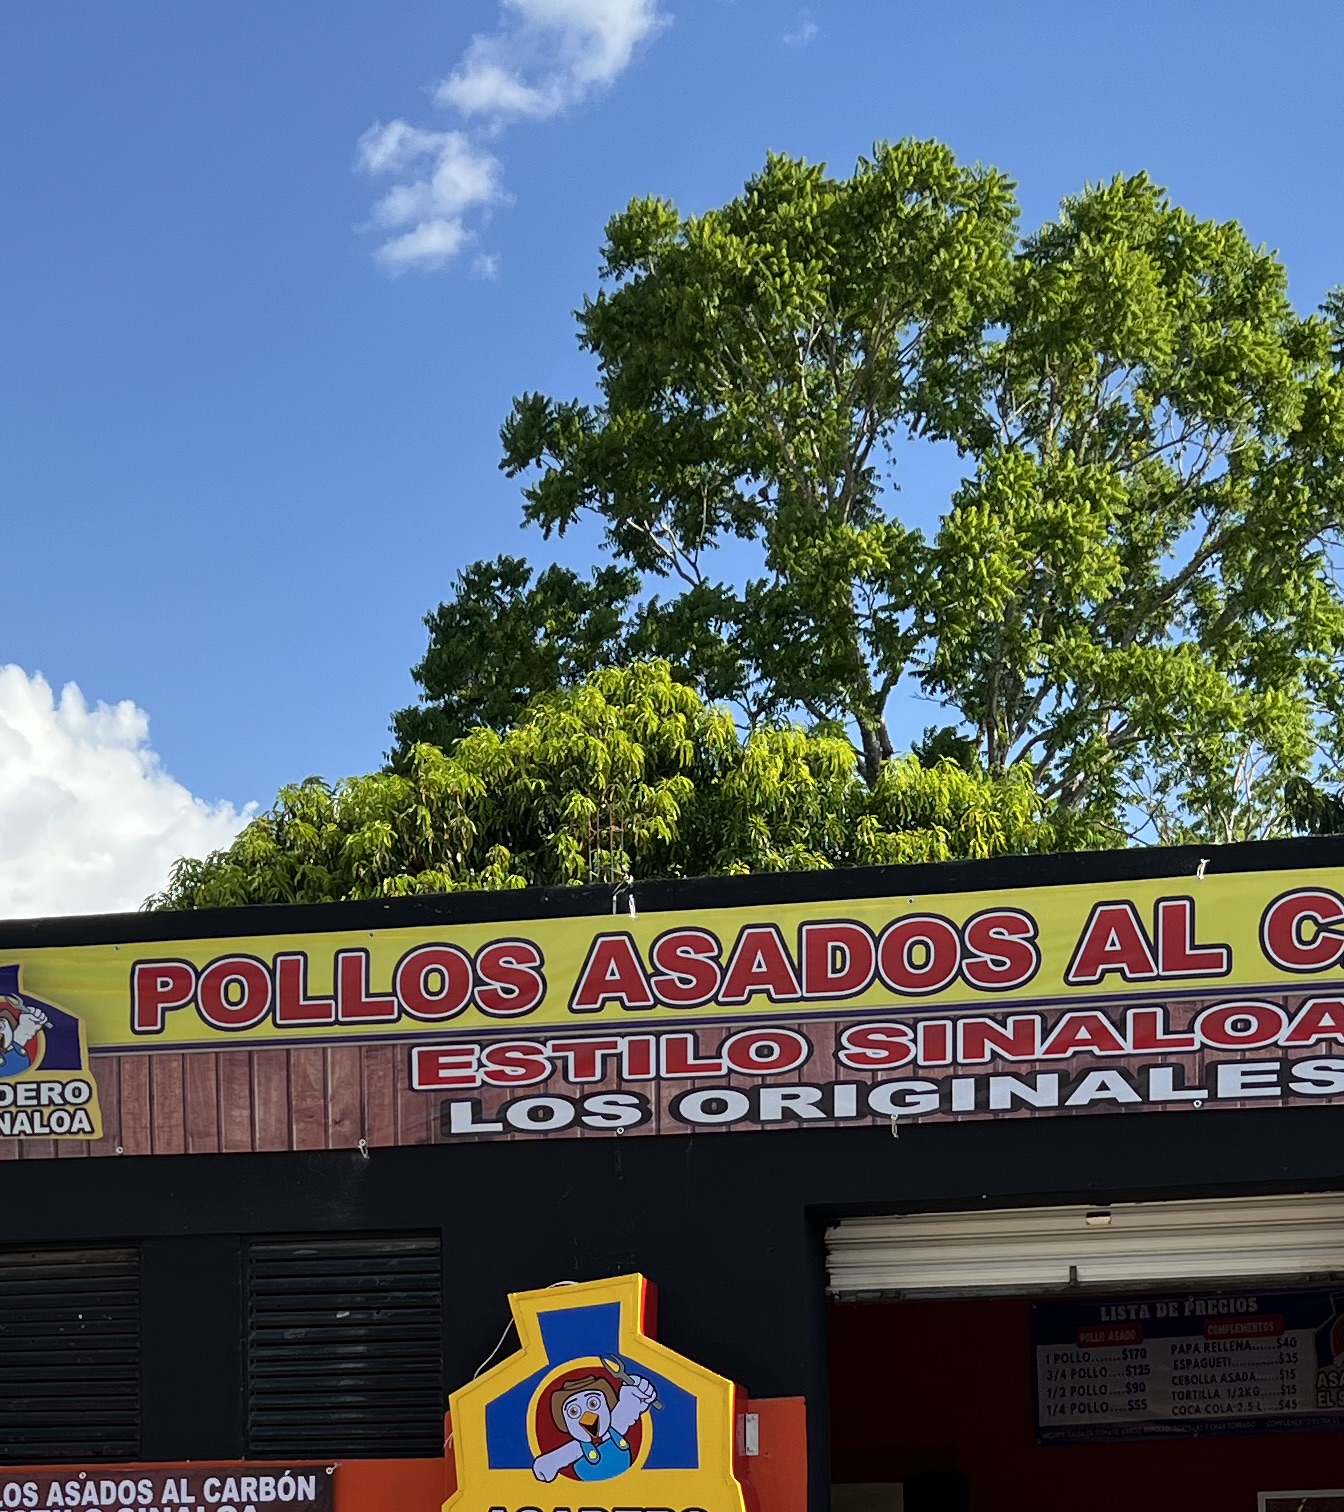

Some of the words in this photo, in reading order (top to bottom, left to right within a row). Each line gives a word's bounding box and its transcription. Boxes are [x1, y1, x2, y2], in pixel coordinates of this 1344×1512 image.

[135, 941, 541, 1031] POLLOS
[573, 907, 1038, 1011] ASADOS
[1067, 896, 1230, 983] AL
[411, 1025, 811, 1091] ESTILO
[451, 1093, 646, 1133] LOS
[1099, 1304, 1150, 1321] LISTA
[1156, 1302, 1178, 1319] DE
[1184, 1297, 1258, 1317] PRECIOS
[1121, 1348, 1147, 1361] $170
[1170, 1343, 1200, 1355] PAPA
[1276, 1337, 1297, 1349] $40
[1279, 1352, 1299, 1365] $35
[1172, 1373, 1217, 1386] CEBOLLA
[1171, 1389, 1220, 1401] TORTILLA
[1317, 1390, 1334, 1408] EL
[1172, 1405, 1201, 1416] COCA
[1204, 1403, 1233, 1415] COLA
[46, 1479, 152, 1507] ASADOS
[161, 1478, 196, 1503] AL
[203, 1470, 316, 1502] CARBÓN
